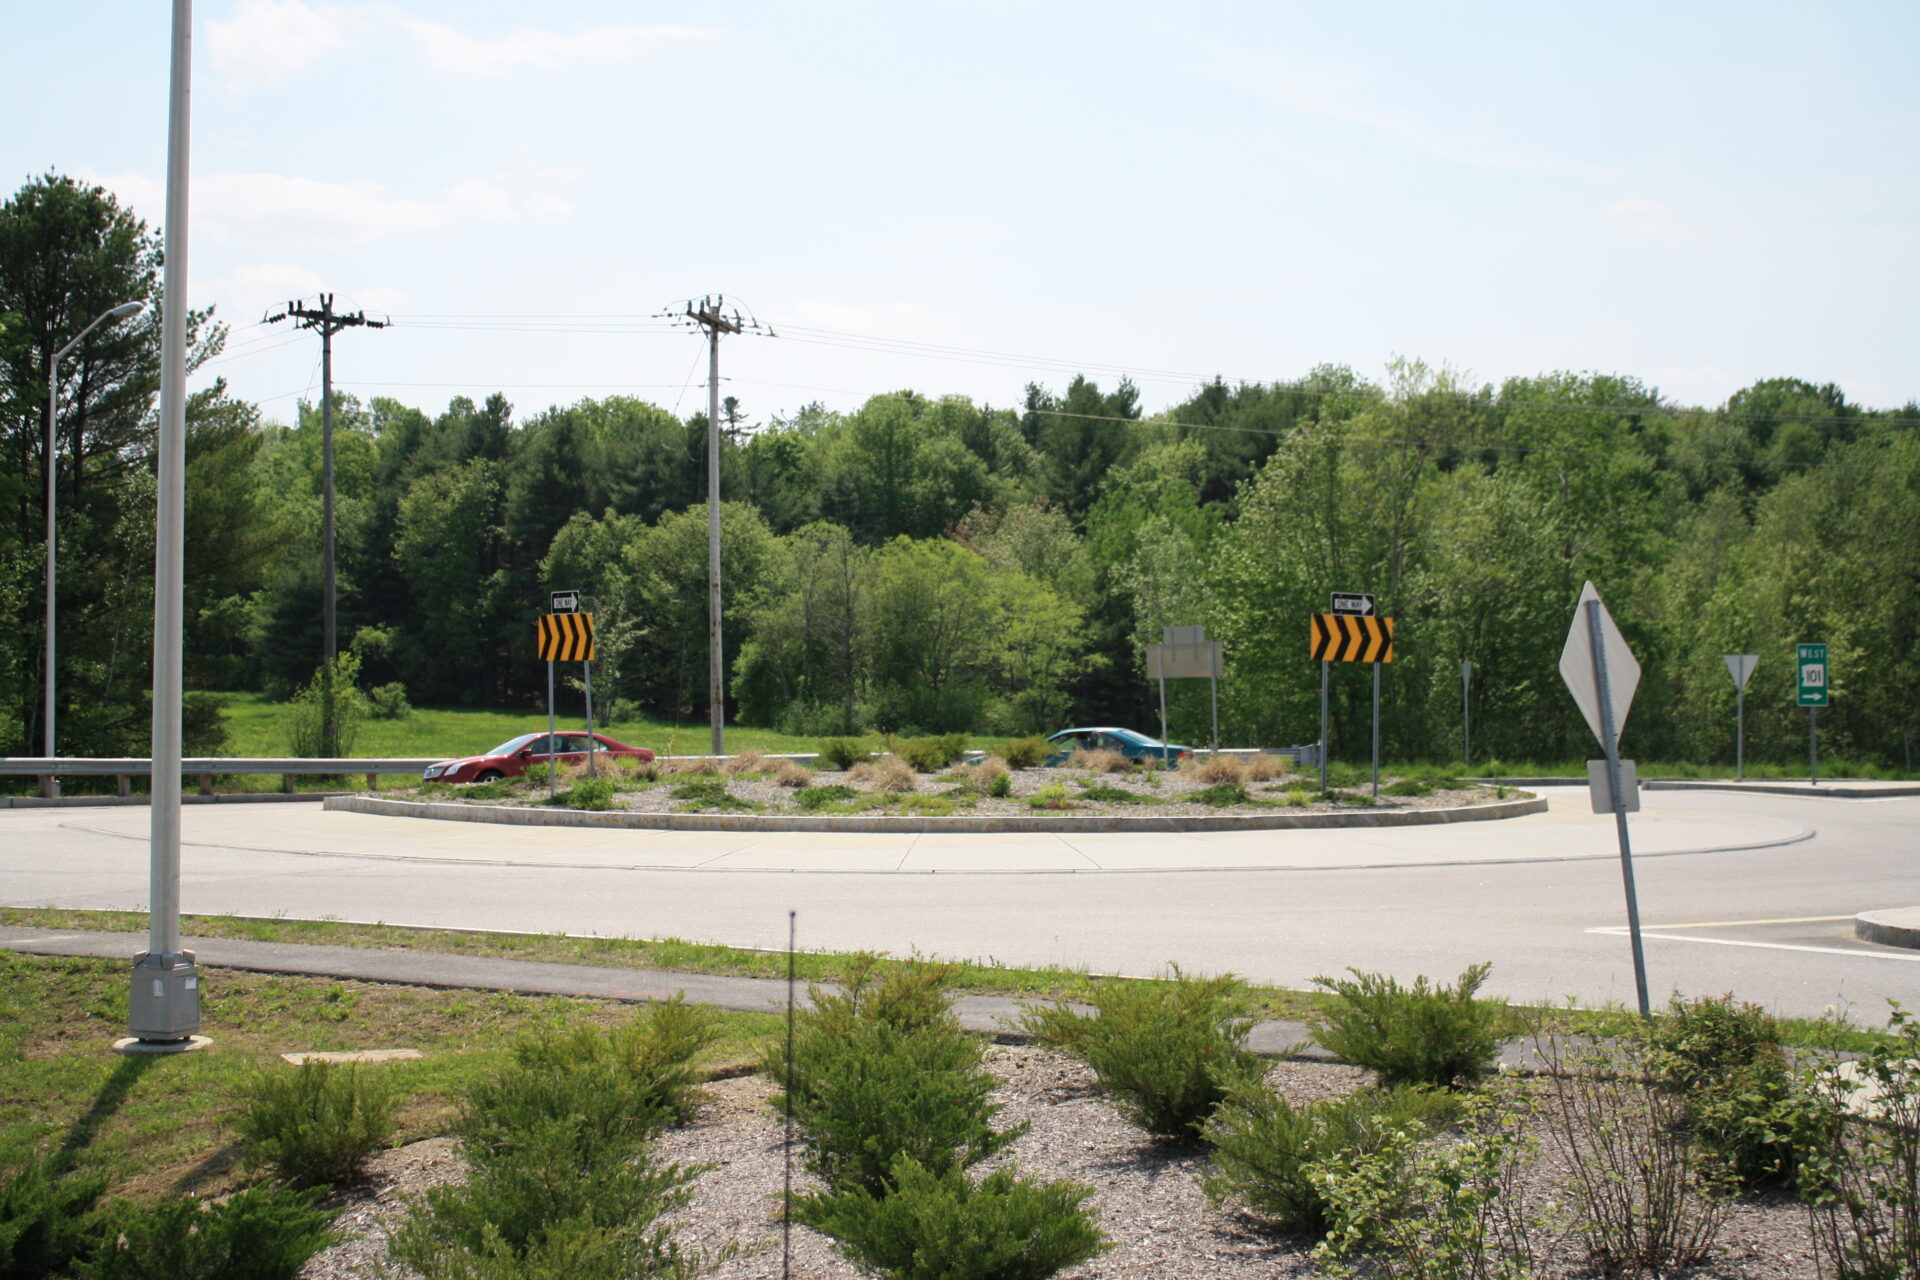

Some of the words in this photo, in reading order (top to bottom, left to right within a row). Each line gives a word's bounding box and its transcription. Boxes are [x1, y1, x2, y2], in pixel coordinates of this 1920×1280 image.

[1337, 599, 1349, 609] ONE
[1351, 600, 1362, 609] WAY
[1800, 649, 1825, 659] WEST
[1805, 670, 1821, 682] 101
